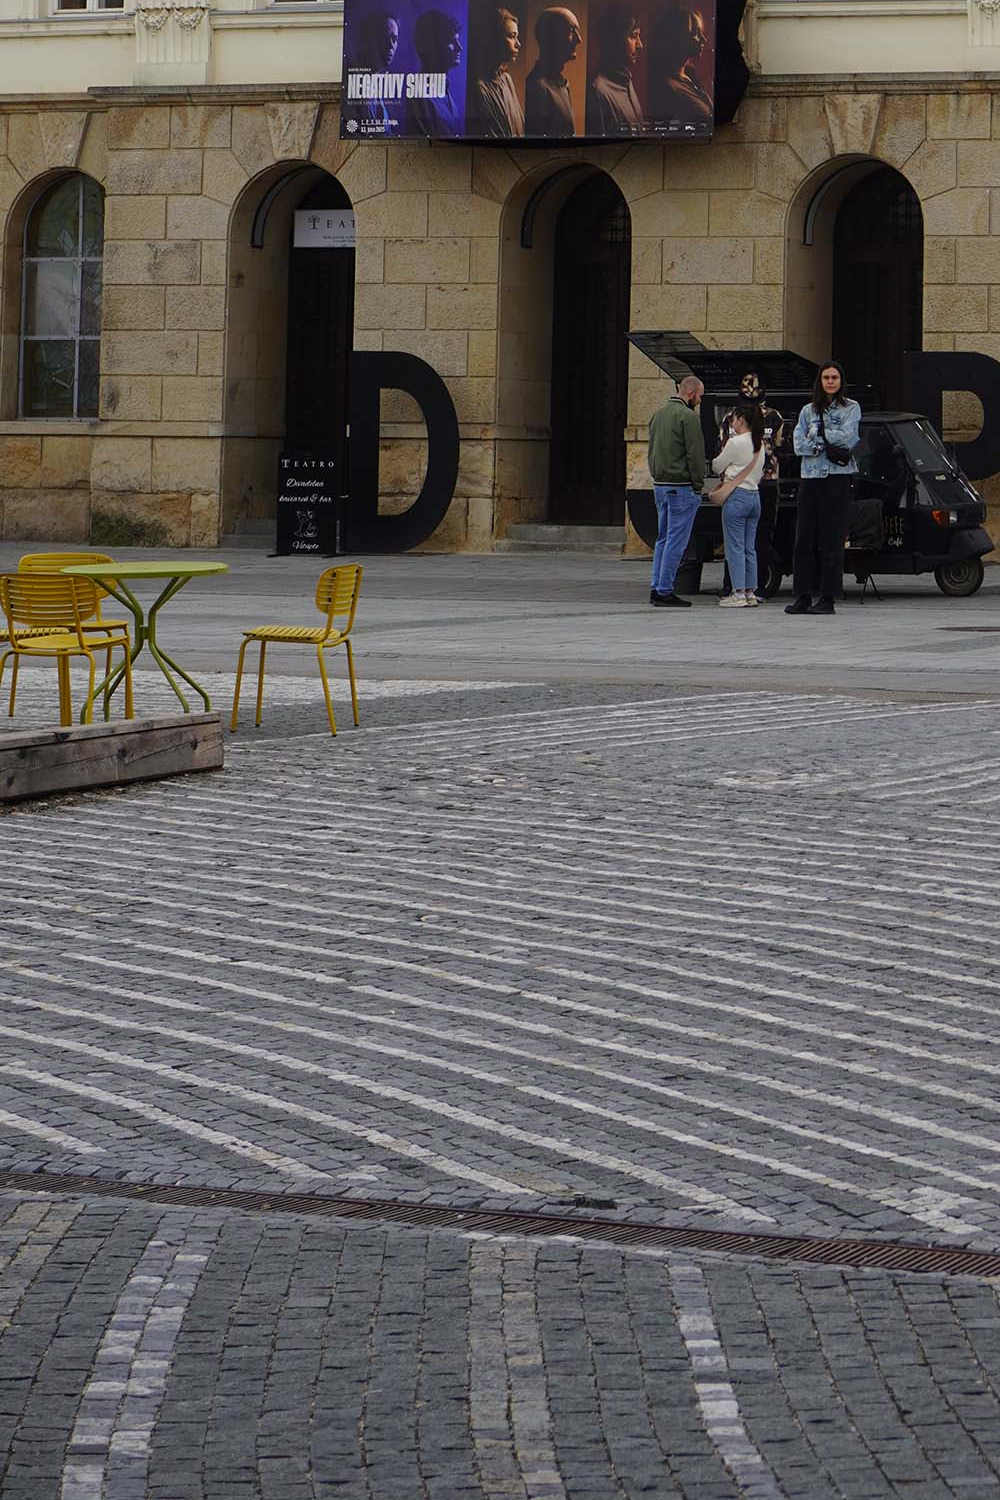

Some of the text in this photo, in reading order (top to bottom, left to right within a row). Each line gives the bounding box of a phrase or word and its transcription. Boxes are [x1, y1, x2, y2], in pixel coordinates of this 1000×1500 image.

[347, 71, 447, 99] NEGATÍVY SNEHU
[280, 458, 336, 468] TEATRO
